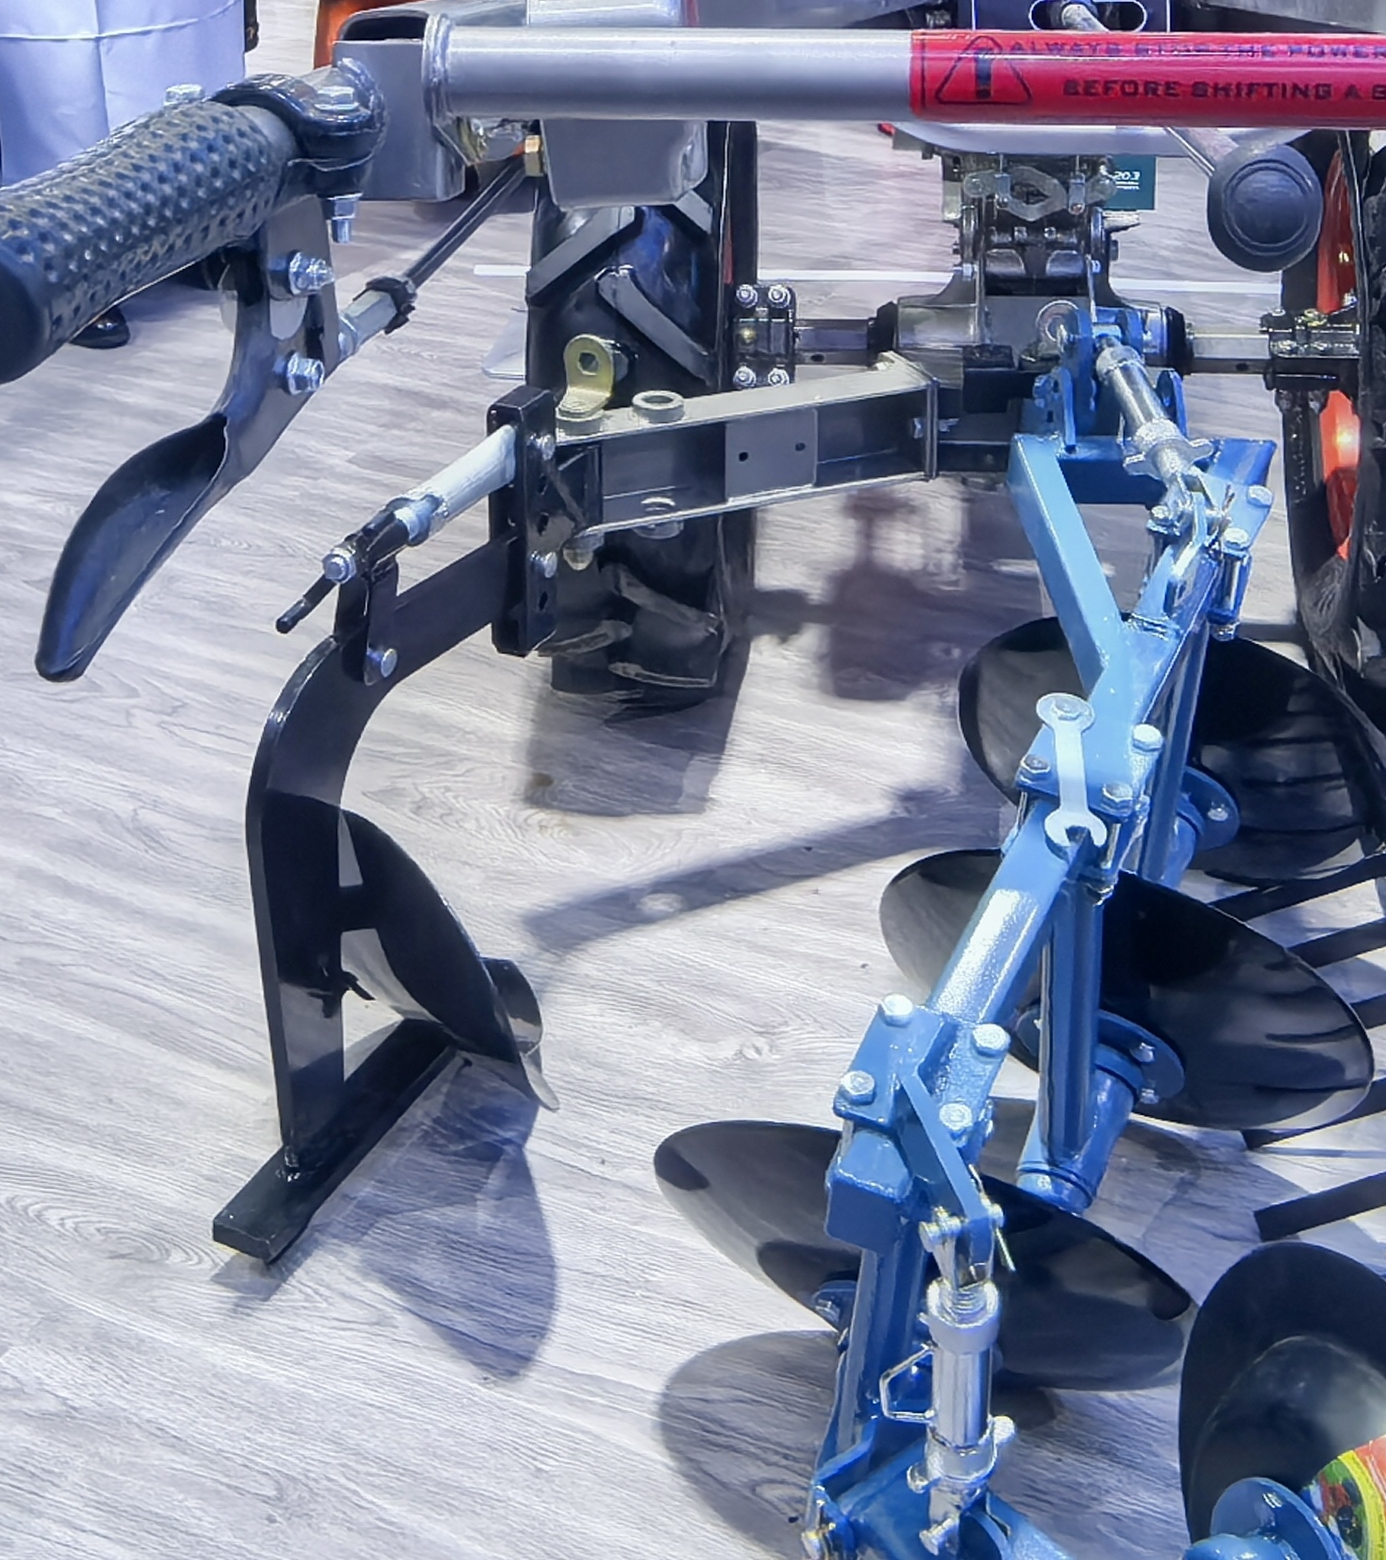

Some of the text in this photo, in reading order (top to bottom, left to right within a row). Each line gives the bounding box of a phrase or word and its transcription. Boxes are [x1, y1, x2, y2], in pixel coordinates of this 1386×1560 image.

[1063, 78, 1181, 98] BEFORE
[1191, 79, 1333, 100] SHIFTING
[1343, 83, 1362, 100] A
